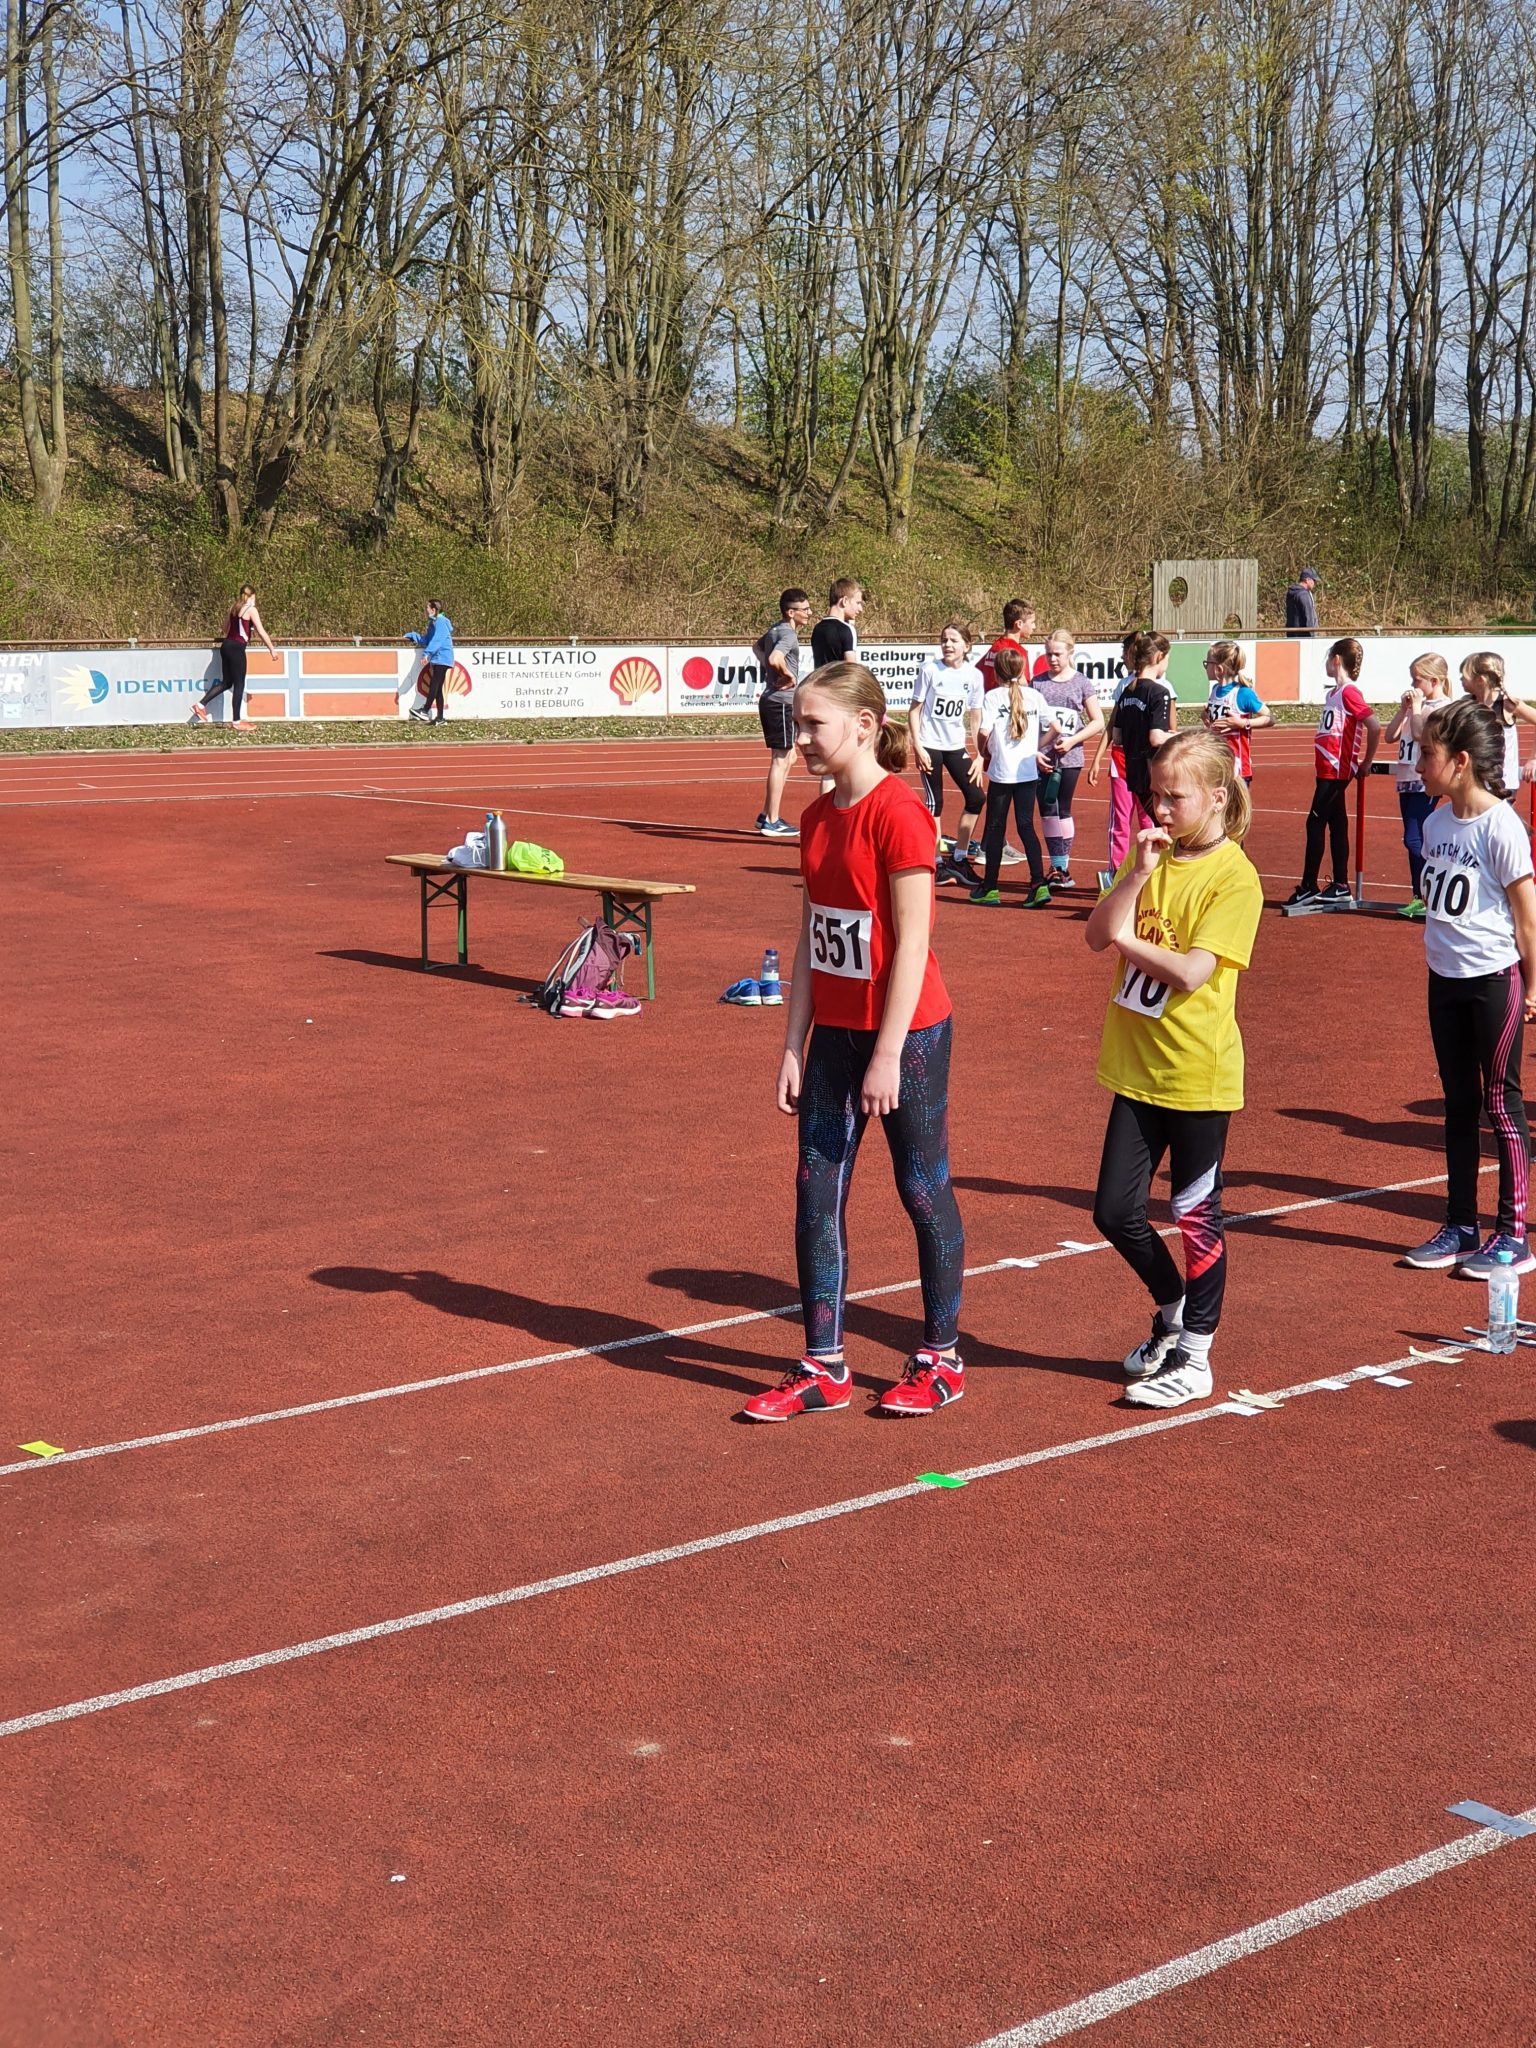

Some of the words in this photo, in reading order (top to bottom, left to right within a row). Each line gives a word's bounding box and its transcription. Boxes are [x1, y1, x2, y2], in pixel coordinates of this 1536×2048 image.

[472, 651, 527, 665] SHELL
[532, 650, 597, 665] STATIO
[860, 650, 926, 663] Bedburg
[482, 671, 508, 679] BIBER
[510, 671, 572, 679] TANKSTELLEN
[575, 670, 602, 678] GmbH
[500, 700, 531, 709] 50181
[535, 698, 585, 708] BEDBURG
[934, 697, 964, 718] 508
[1055, 710, 1075, 731] 54
[1399, 739, 1415, 761] 81
[1422, 865, 1471, 917] 510
[812, 912, 863, 970] 551
